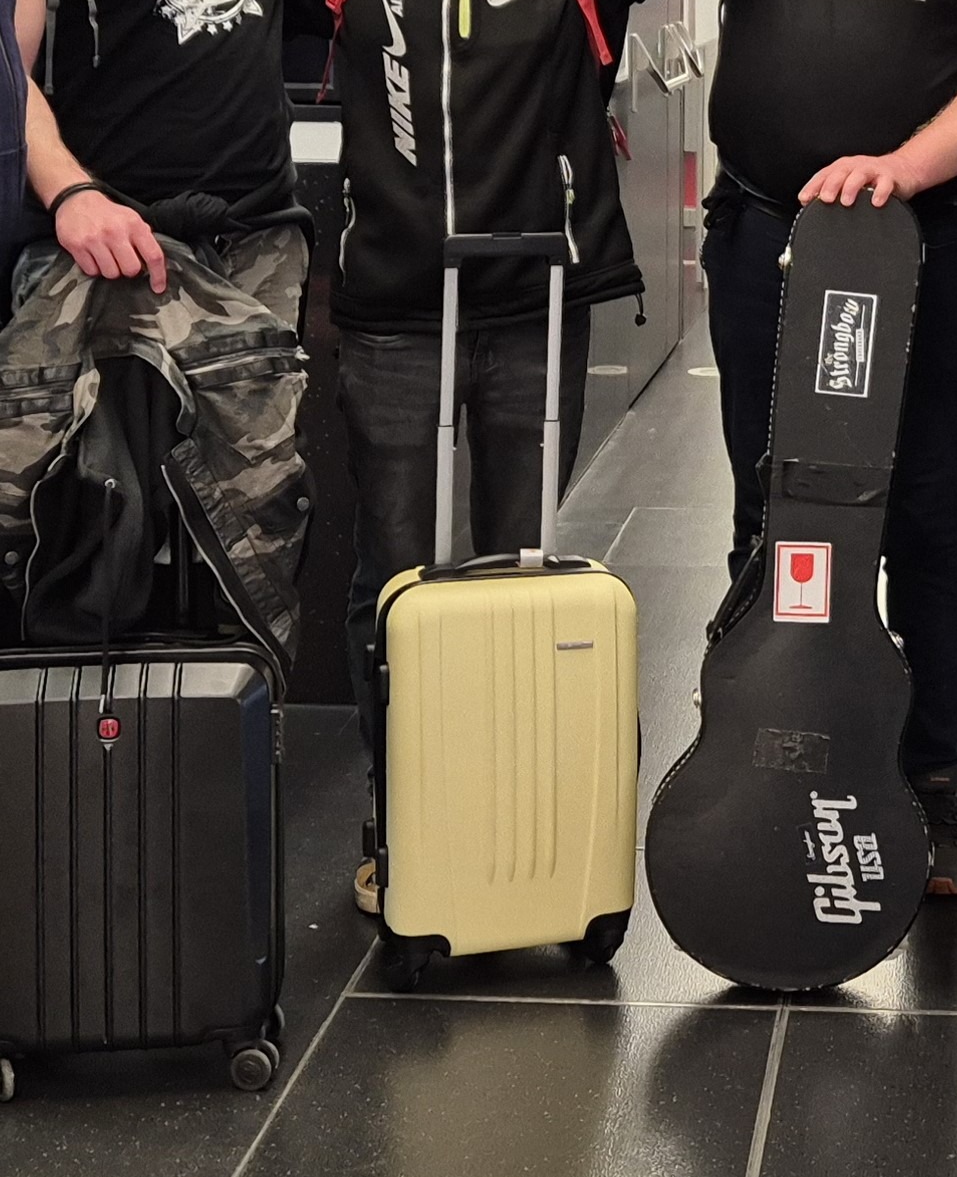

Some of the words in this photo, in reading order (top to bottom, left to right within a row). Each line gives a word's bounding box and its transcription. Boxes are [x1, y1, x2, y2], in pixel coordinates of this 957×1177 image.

[382, 50, 418, 168] NIKE
[829, 298, 861, 391] Strongbow
[806, 793, 882, 924] Gibson
